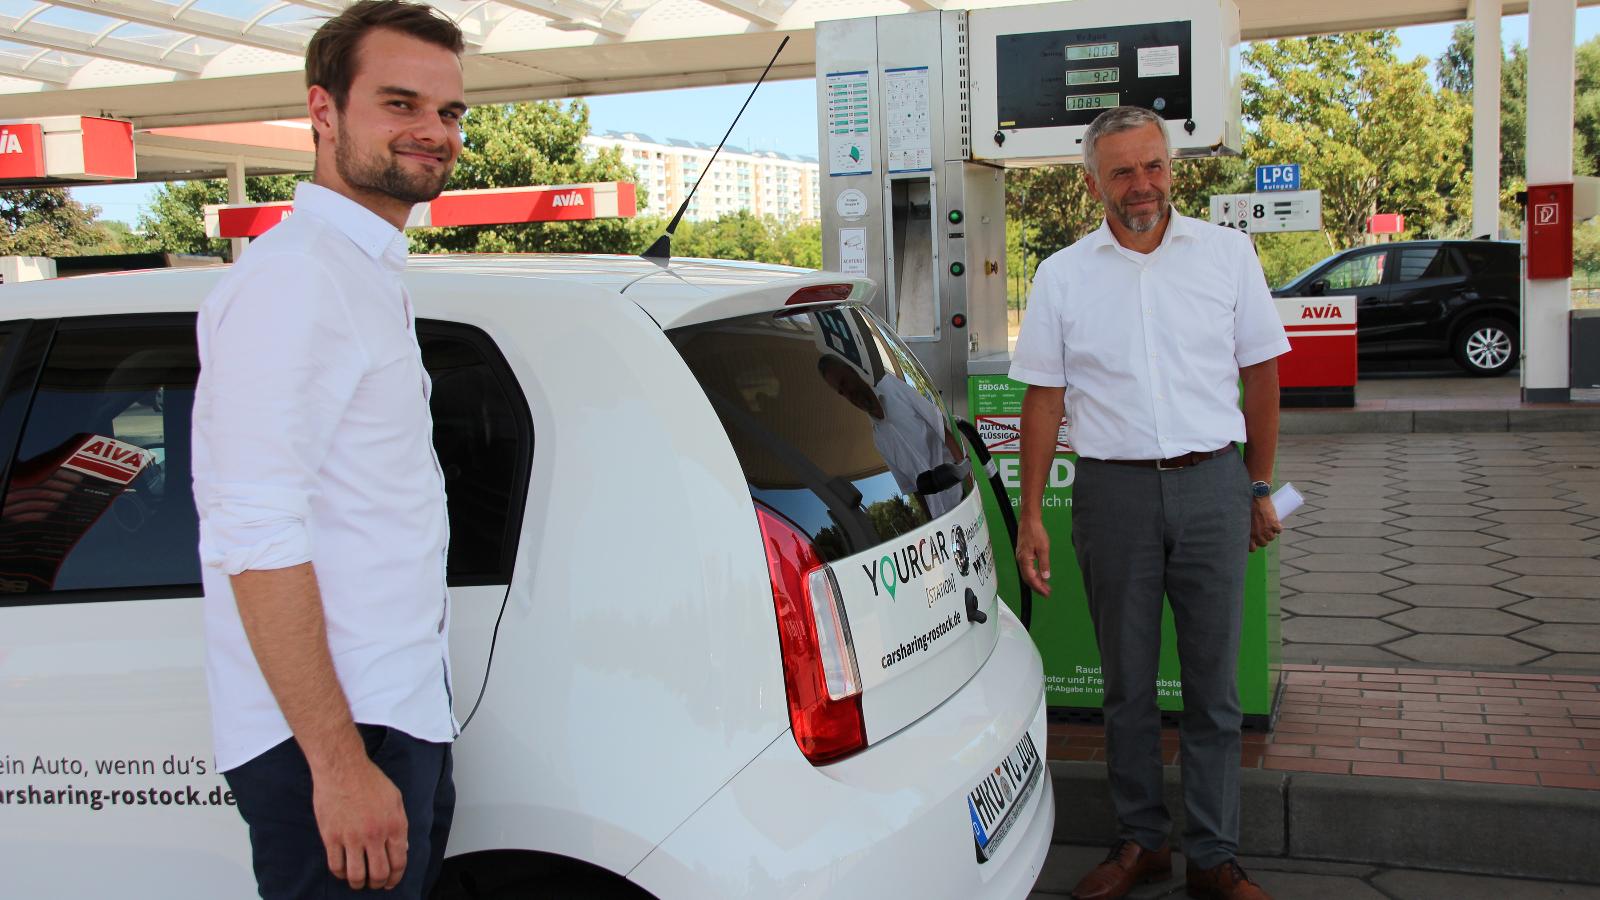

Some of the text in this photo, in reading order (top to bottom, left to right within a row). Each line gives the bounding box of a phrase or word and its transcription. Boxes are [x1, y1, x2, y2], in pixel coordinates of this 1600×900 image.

[1262, 167, 1293, 183] LPG
[552, 191, 584, 207] AVIA
[1252, 204, 1265, 218] 8
[1301, 304, 1342, 319] AVIA
[980, 432, 1021, 440] FLÜSSIGGA
[862, 530, 950, 603] YOURCAR
[881, 610, 962, 669] carsharing-rostock.de
[1068, 676, 1085, 684] und
[1088, 677, 1105, 685] Fre
[1156, 679, 1182, 687] abste
[32, 755, 89, 777] Auto,
[95, 759, 155, 775] wenn
